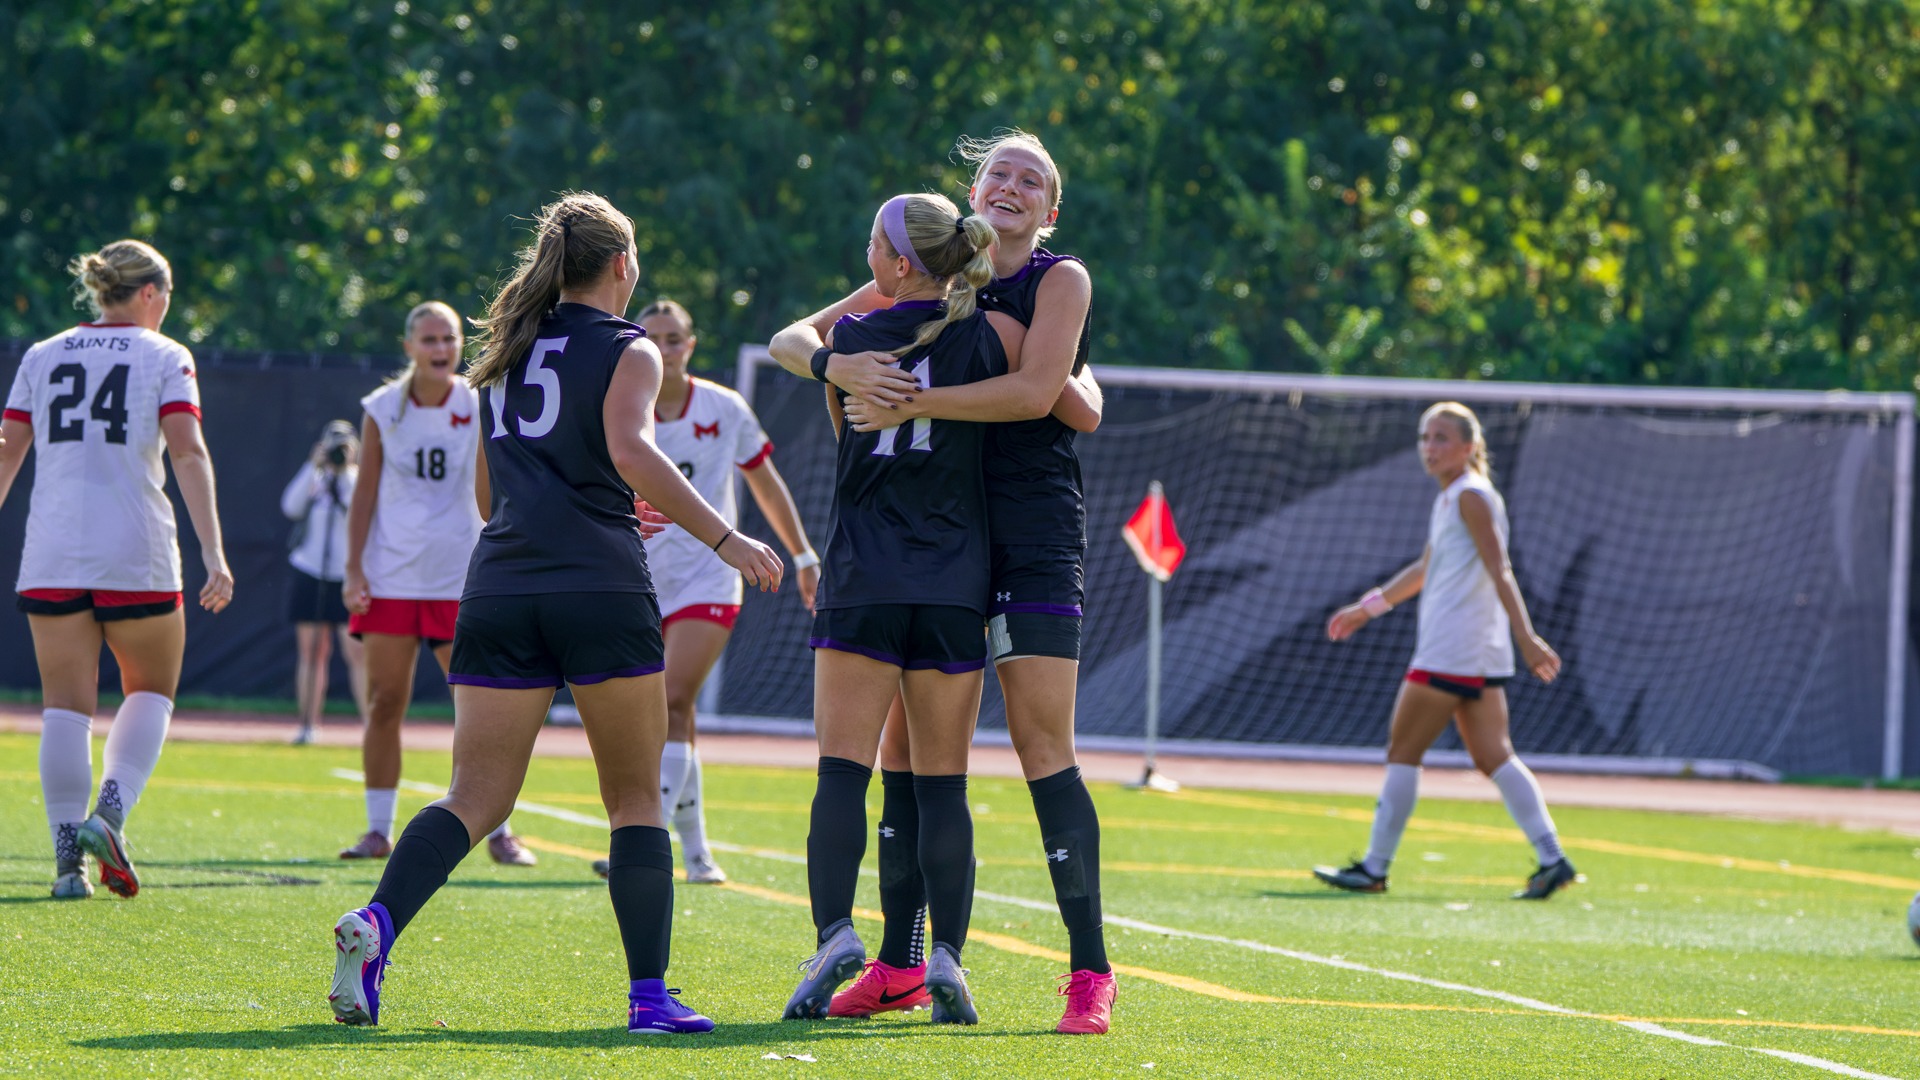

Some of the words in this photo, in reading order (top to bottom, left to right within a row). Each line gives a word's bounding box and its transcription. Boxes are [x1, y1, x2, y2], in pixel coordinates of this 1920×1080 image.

[64, 336, 131, 351] SAINTS
[49, 362, 131, 445] 24
[871, 355, 933, 456] 1
[693, 420, 720, 441] M
[414, 447, 447, 481] 18
